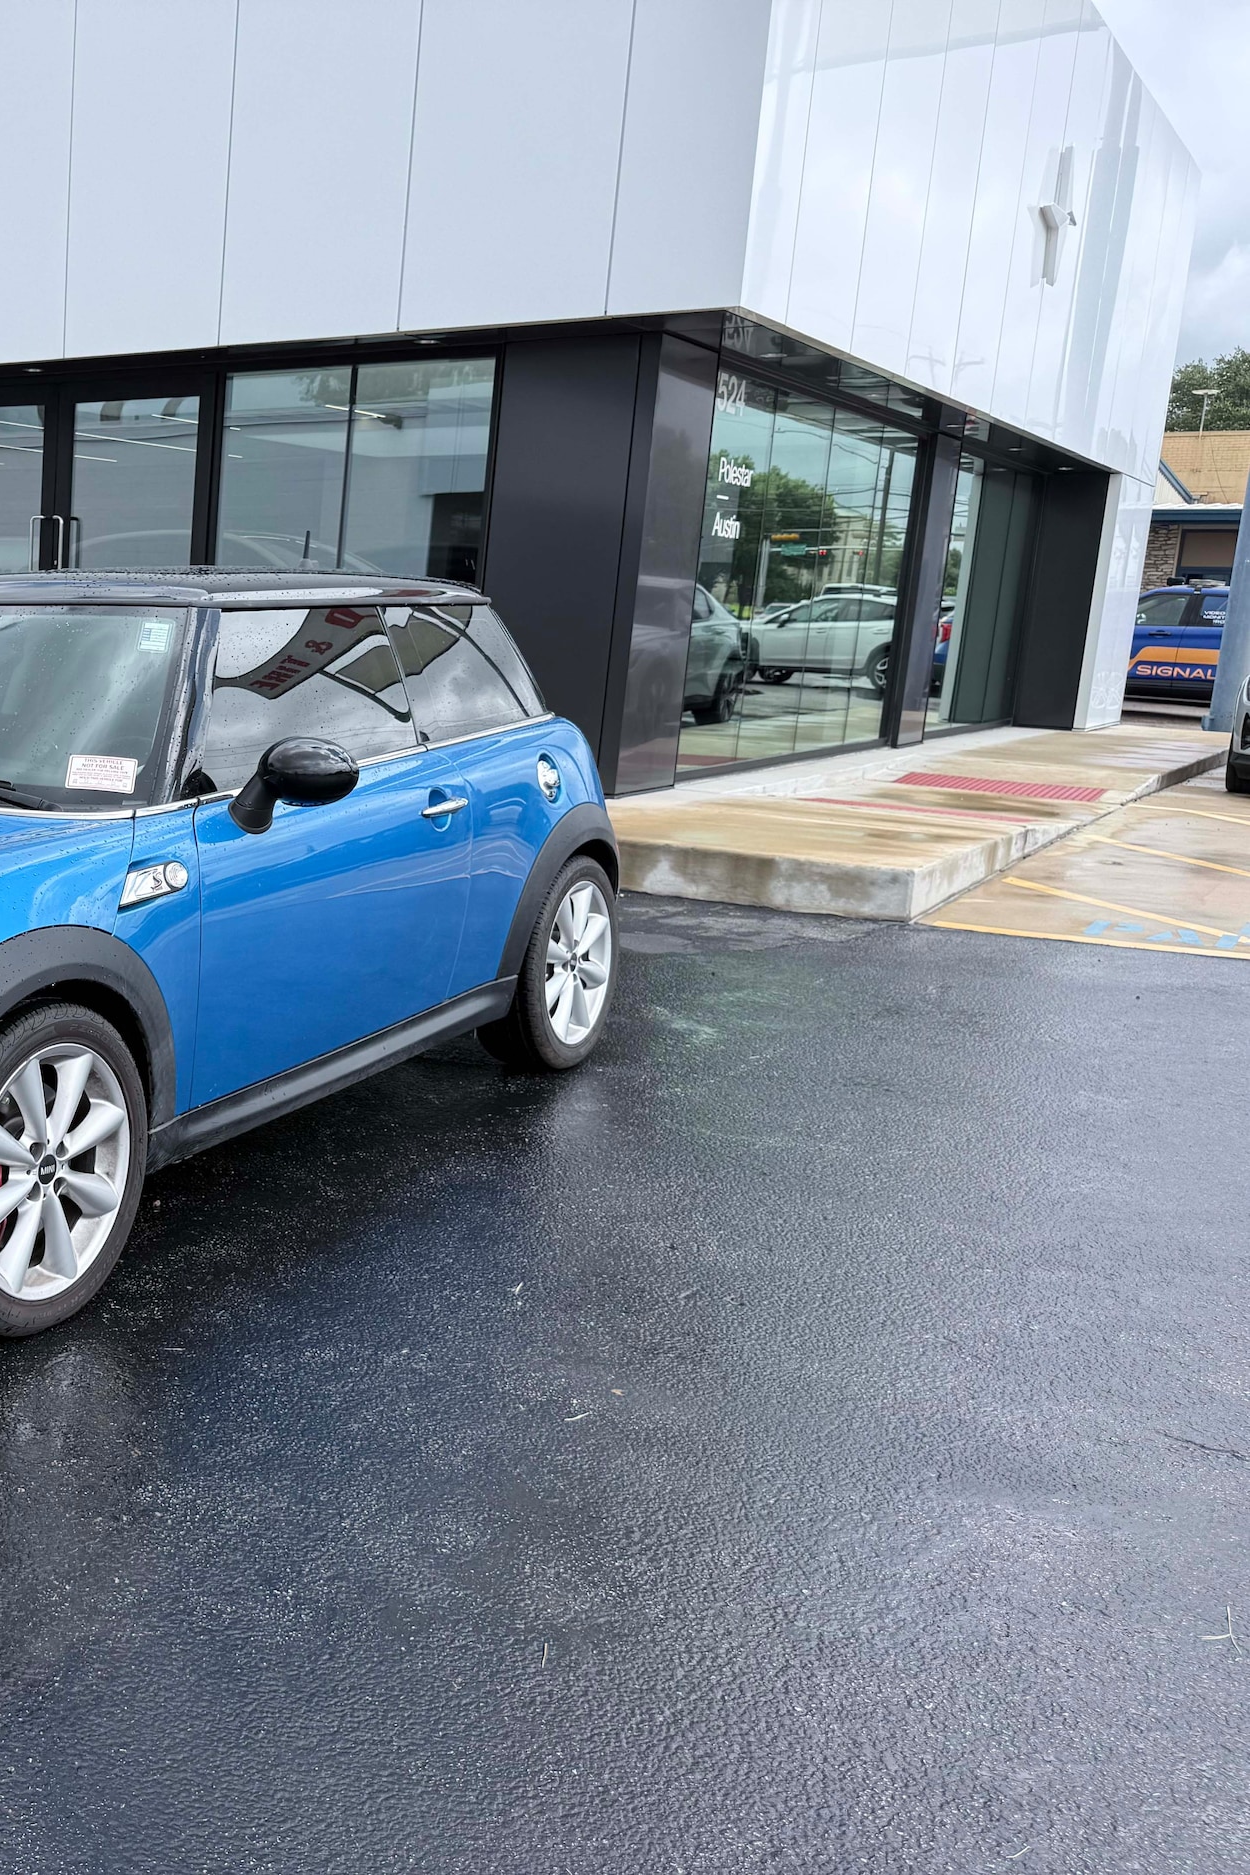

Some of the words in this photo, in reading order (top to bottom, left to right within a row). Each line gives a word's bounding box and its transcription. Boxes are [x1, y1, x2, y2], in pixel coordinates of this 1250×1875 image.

[717, 371, 746, 417] 524
[718, 456, 754, 488] Polestar
[711, 511, 740, 540] Austin
[1135, 664, 1217, 680] SIGNAL
[40, 1164, 56, 1176] MINI
